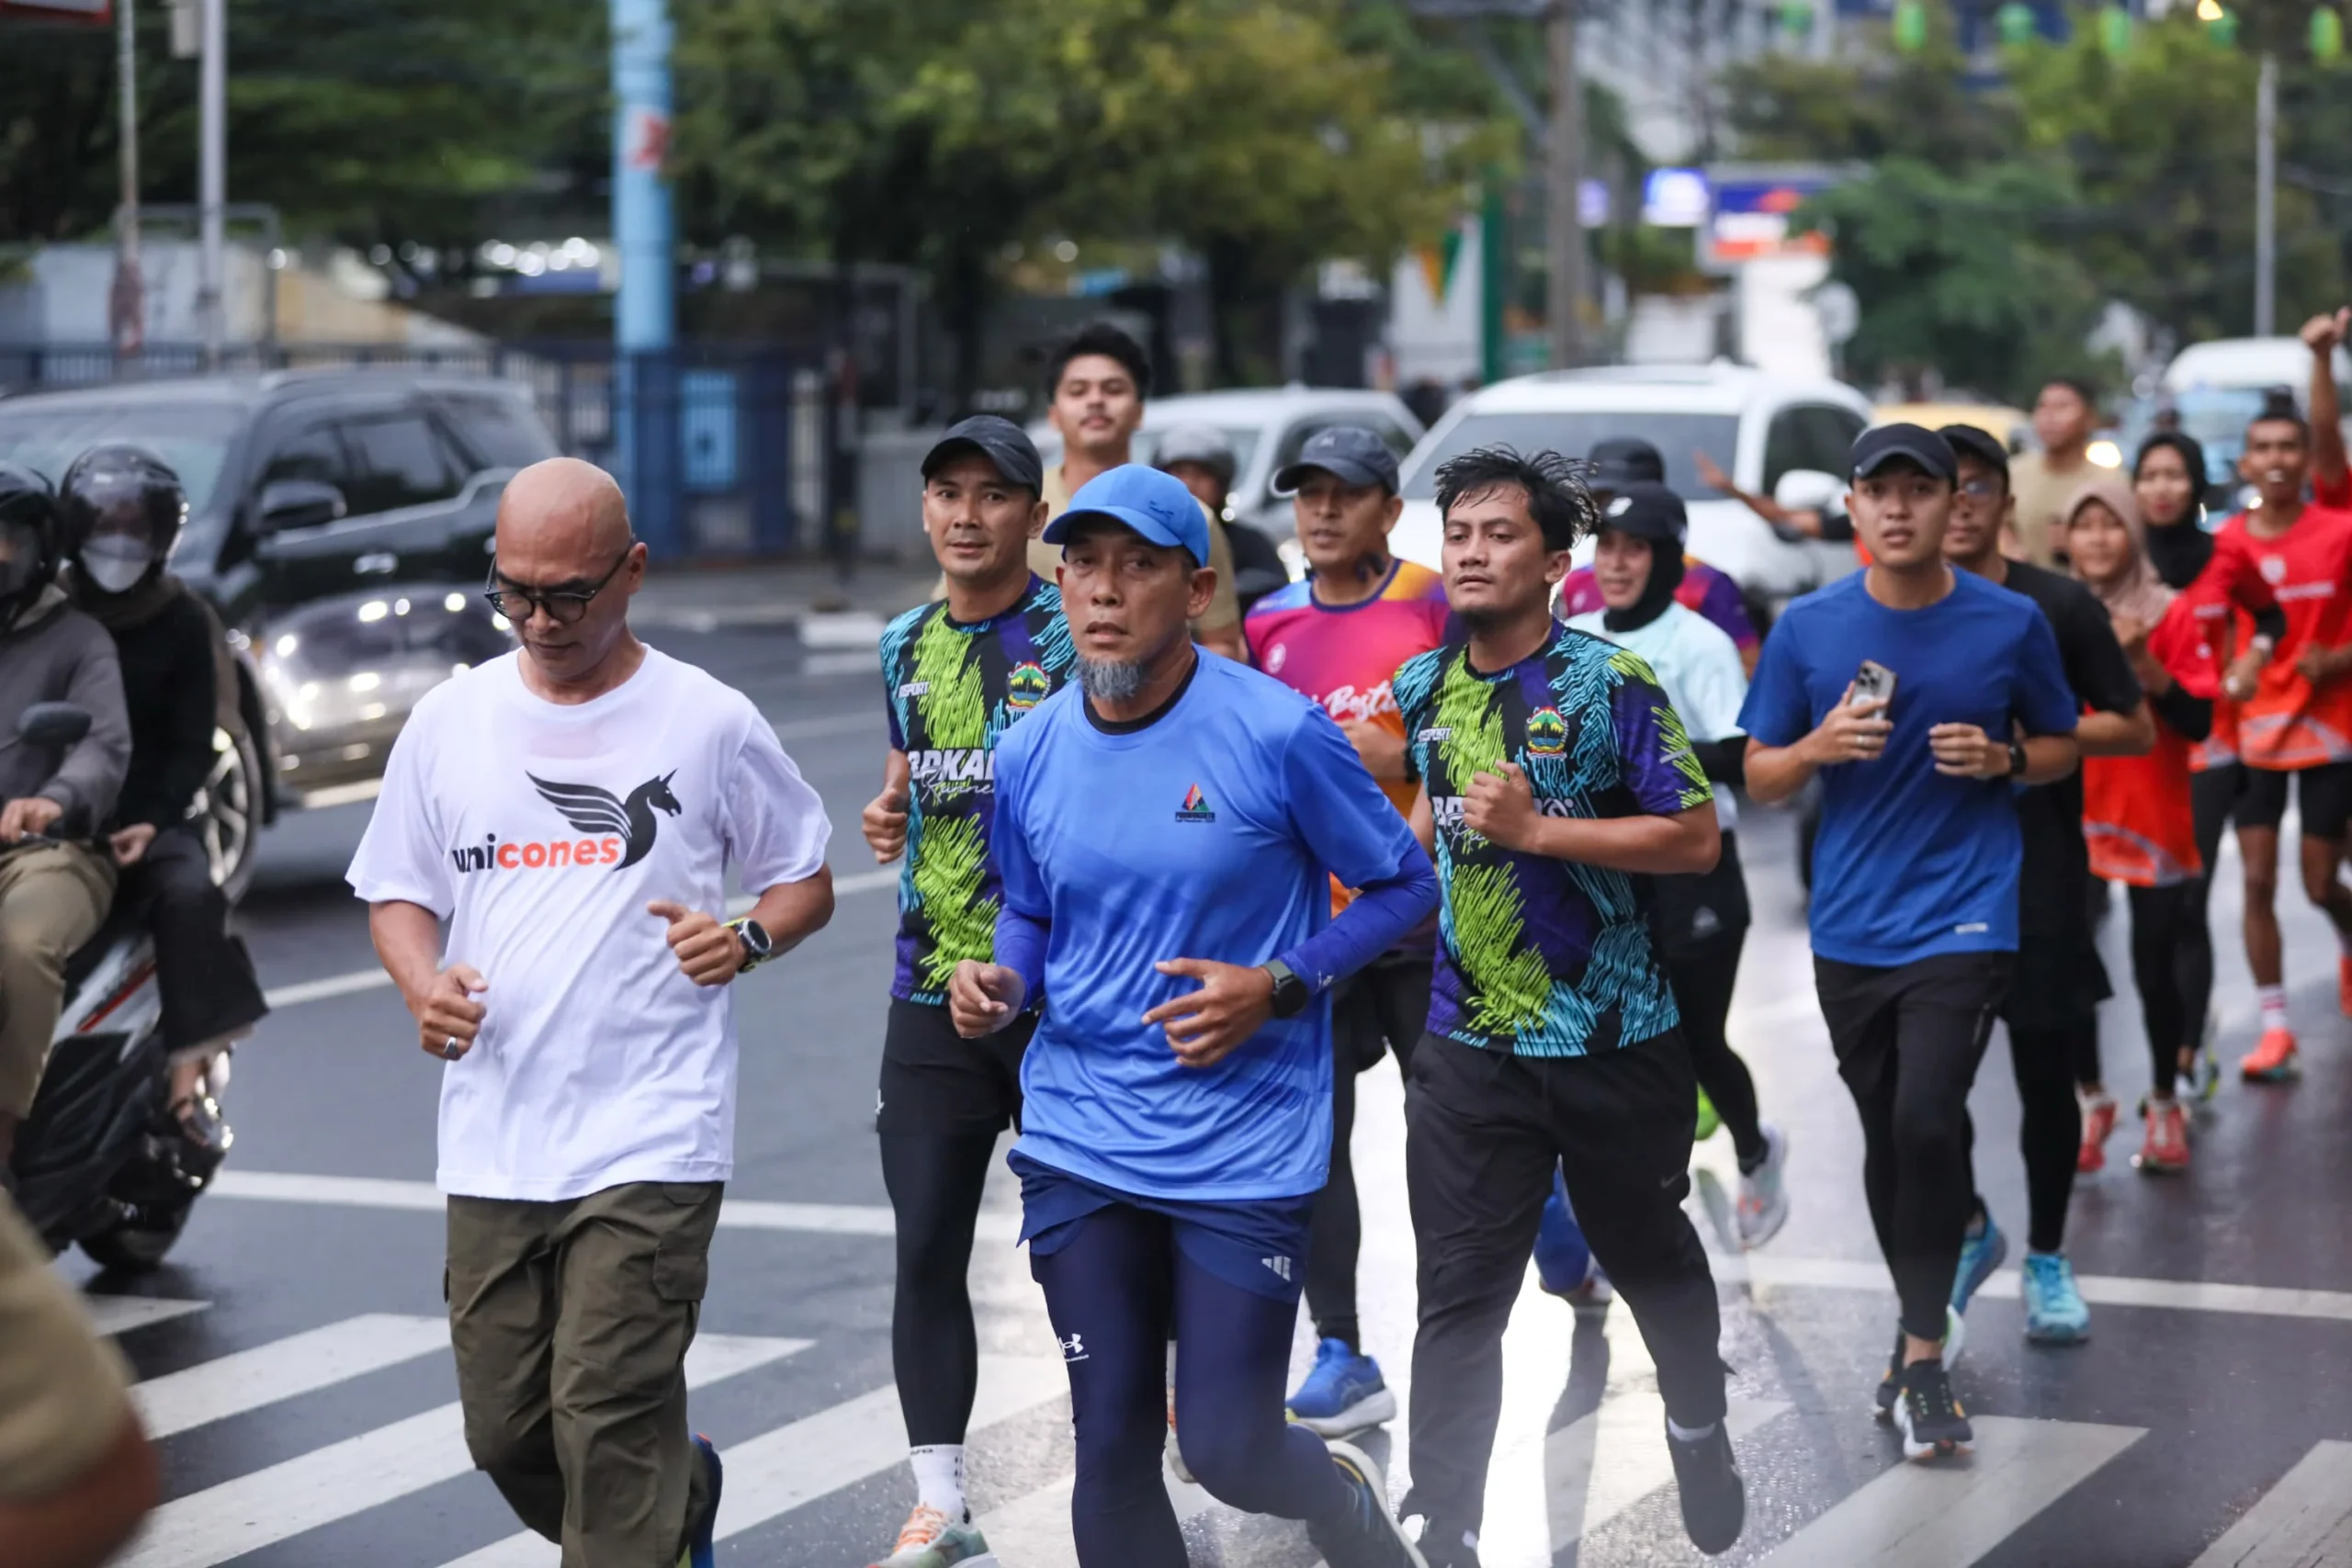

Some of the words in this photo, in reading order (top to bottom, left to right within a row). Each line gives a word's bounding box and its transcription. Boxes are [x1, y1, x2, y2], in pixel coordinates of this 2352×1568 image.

[908, 750, 995, 781] BPKA
[921, 768, 995, 804] Runne
[453, 833, 621, 873] unicones
